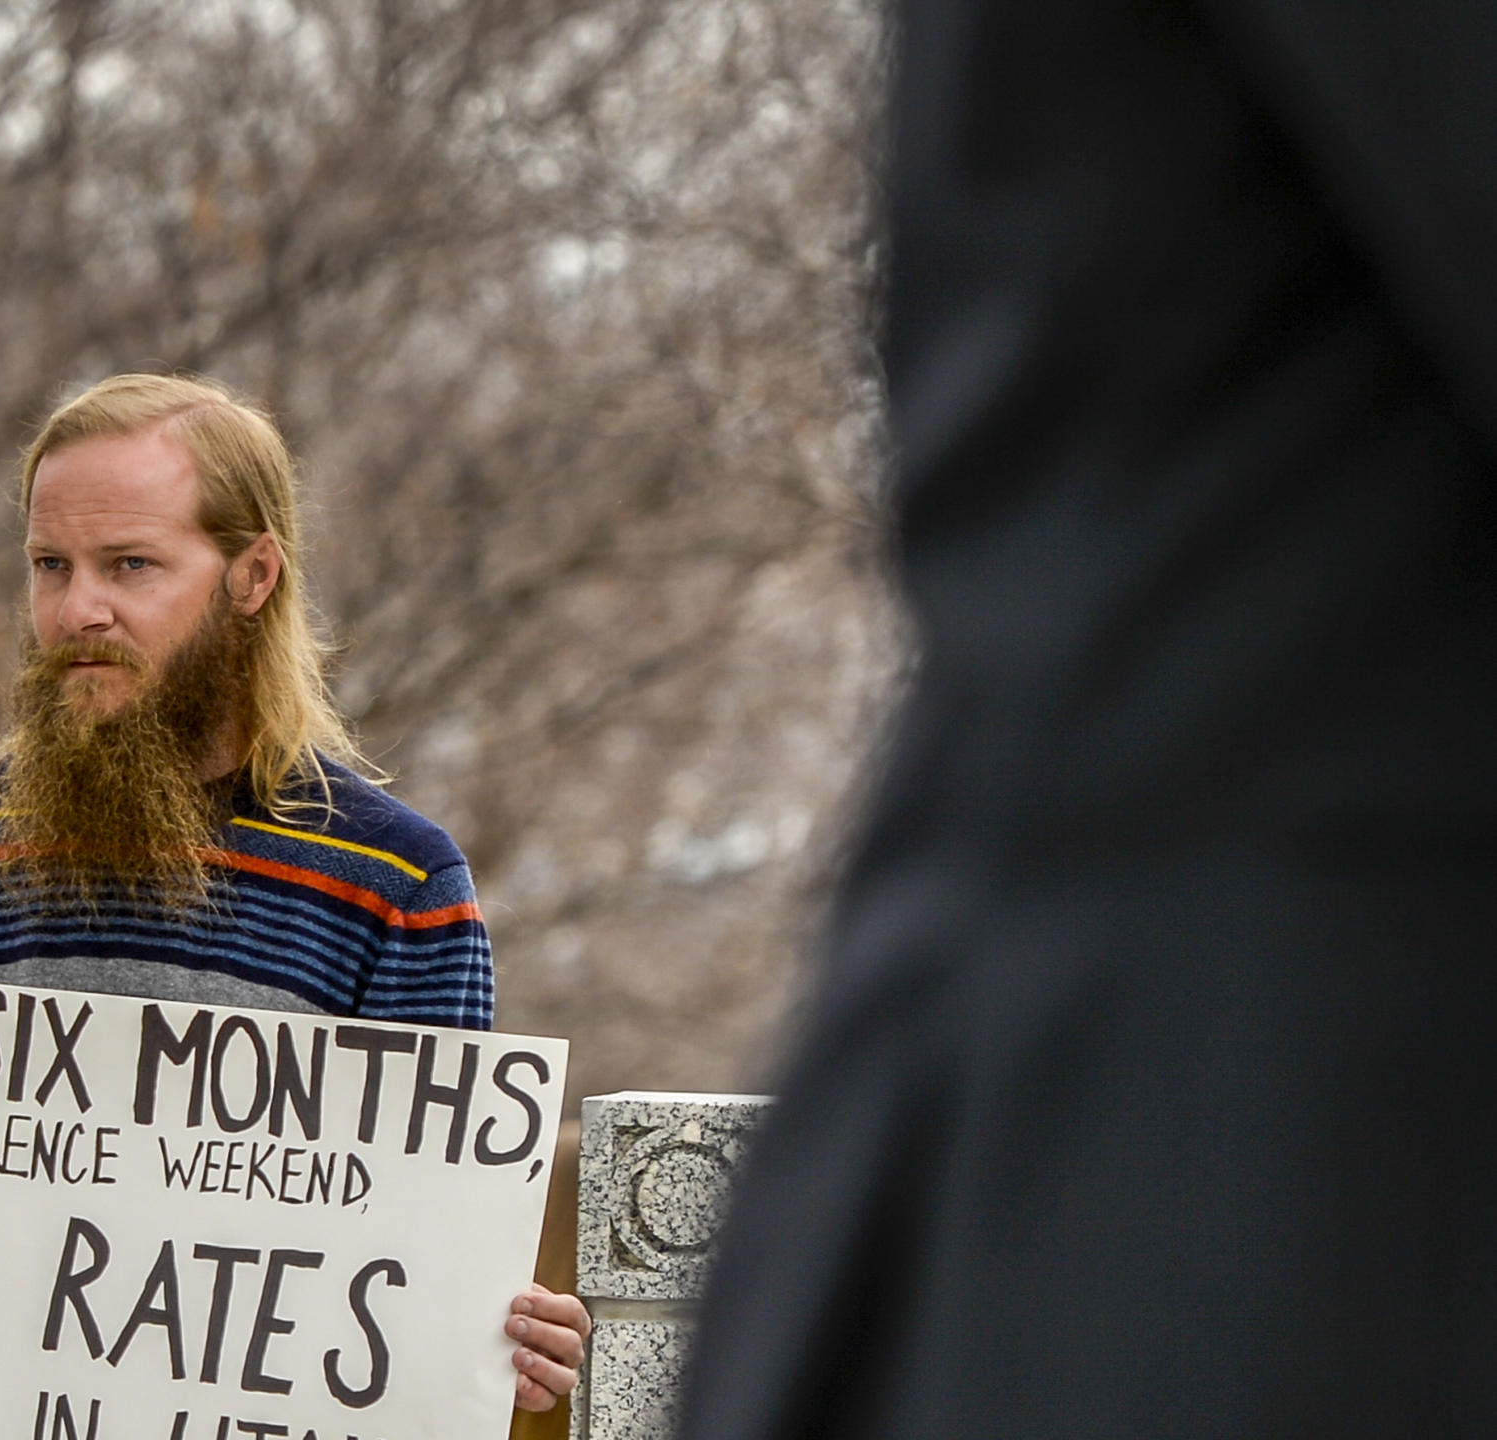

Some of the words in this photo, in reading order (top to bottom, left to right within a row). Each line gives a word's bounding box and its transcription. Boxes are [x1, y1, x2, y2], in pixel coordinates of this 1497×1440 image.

[132, 1003, 550, 1185] MONTHS,
[158, 1136, 372, 1215] WEEKEND,
[41, 1216, 407, 1409] RATES
